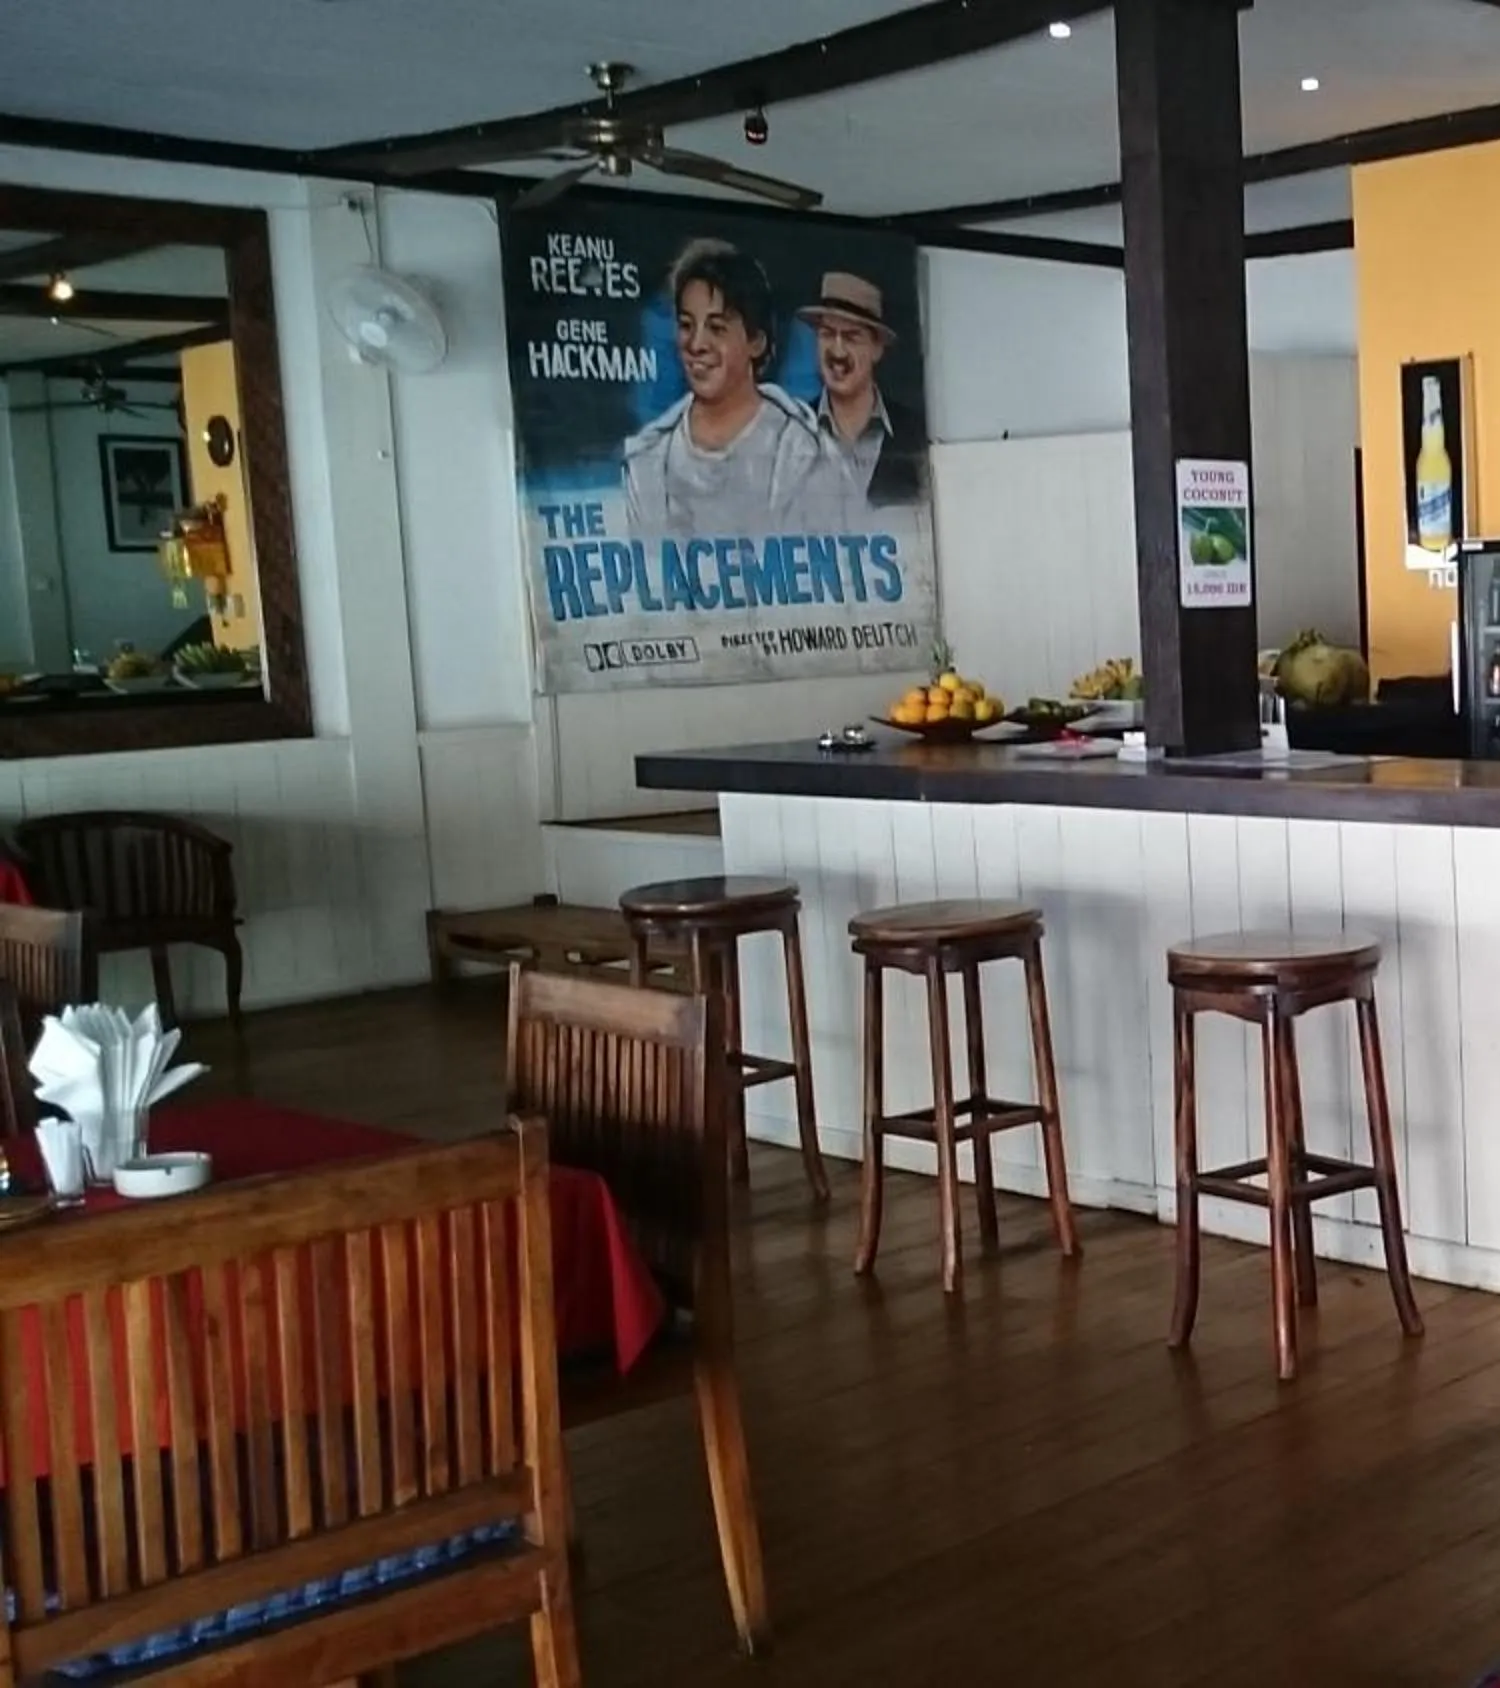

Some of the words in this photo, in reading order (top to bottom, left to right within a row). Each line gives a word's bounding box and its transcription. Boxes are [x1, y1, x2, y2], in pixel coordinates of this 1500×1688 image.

[547, 233, 615, 261] KEANU
[556, 319, 608, 343] GENE
[528, 340, 658, 383] HACKMAN
[1191, 469, 1234, 483] YOUNG
[1183, 487, 1242, 502] COCONUT
[539, 503, 606, 539] THE
[543, 533, 904, 622] REPLACEMENTS
[631, 642, 686, 662] DOLBY
[778, 626, 848, 656] HOWARD
[851, 622, 919, 649] DEUTCH
